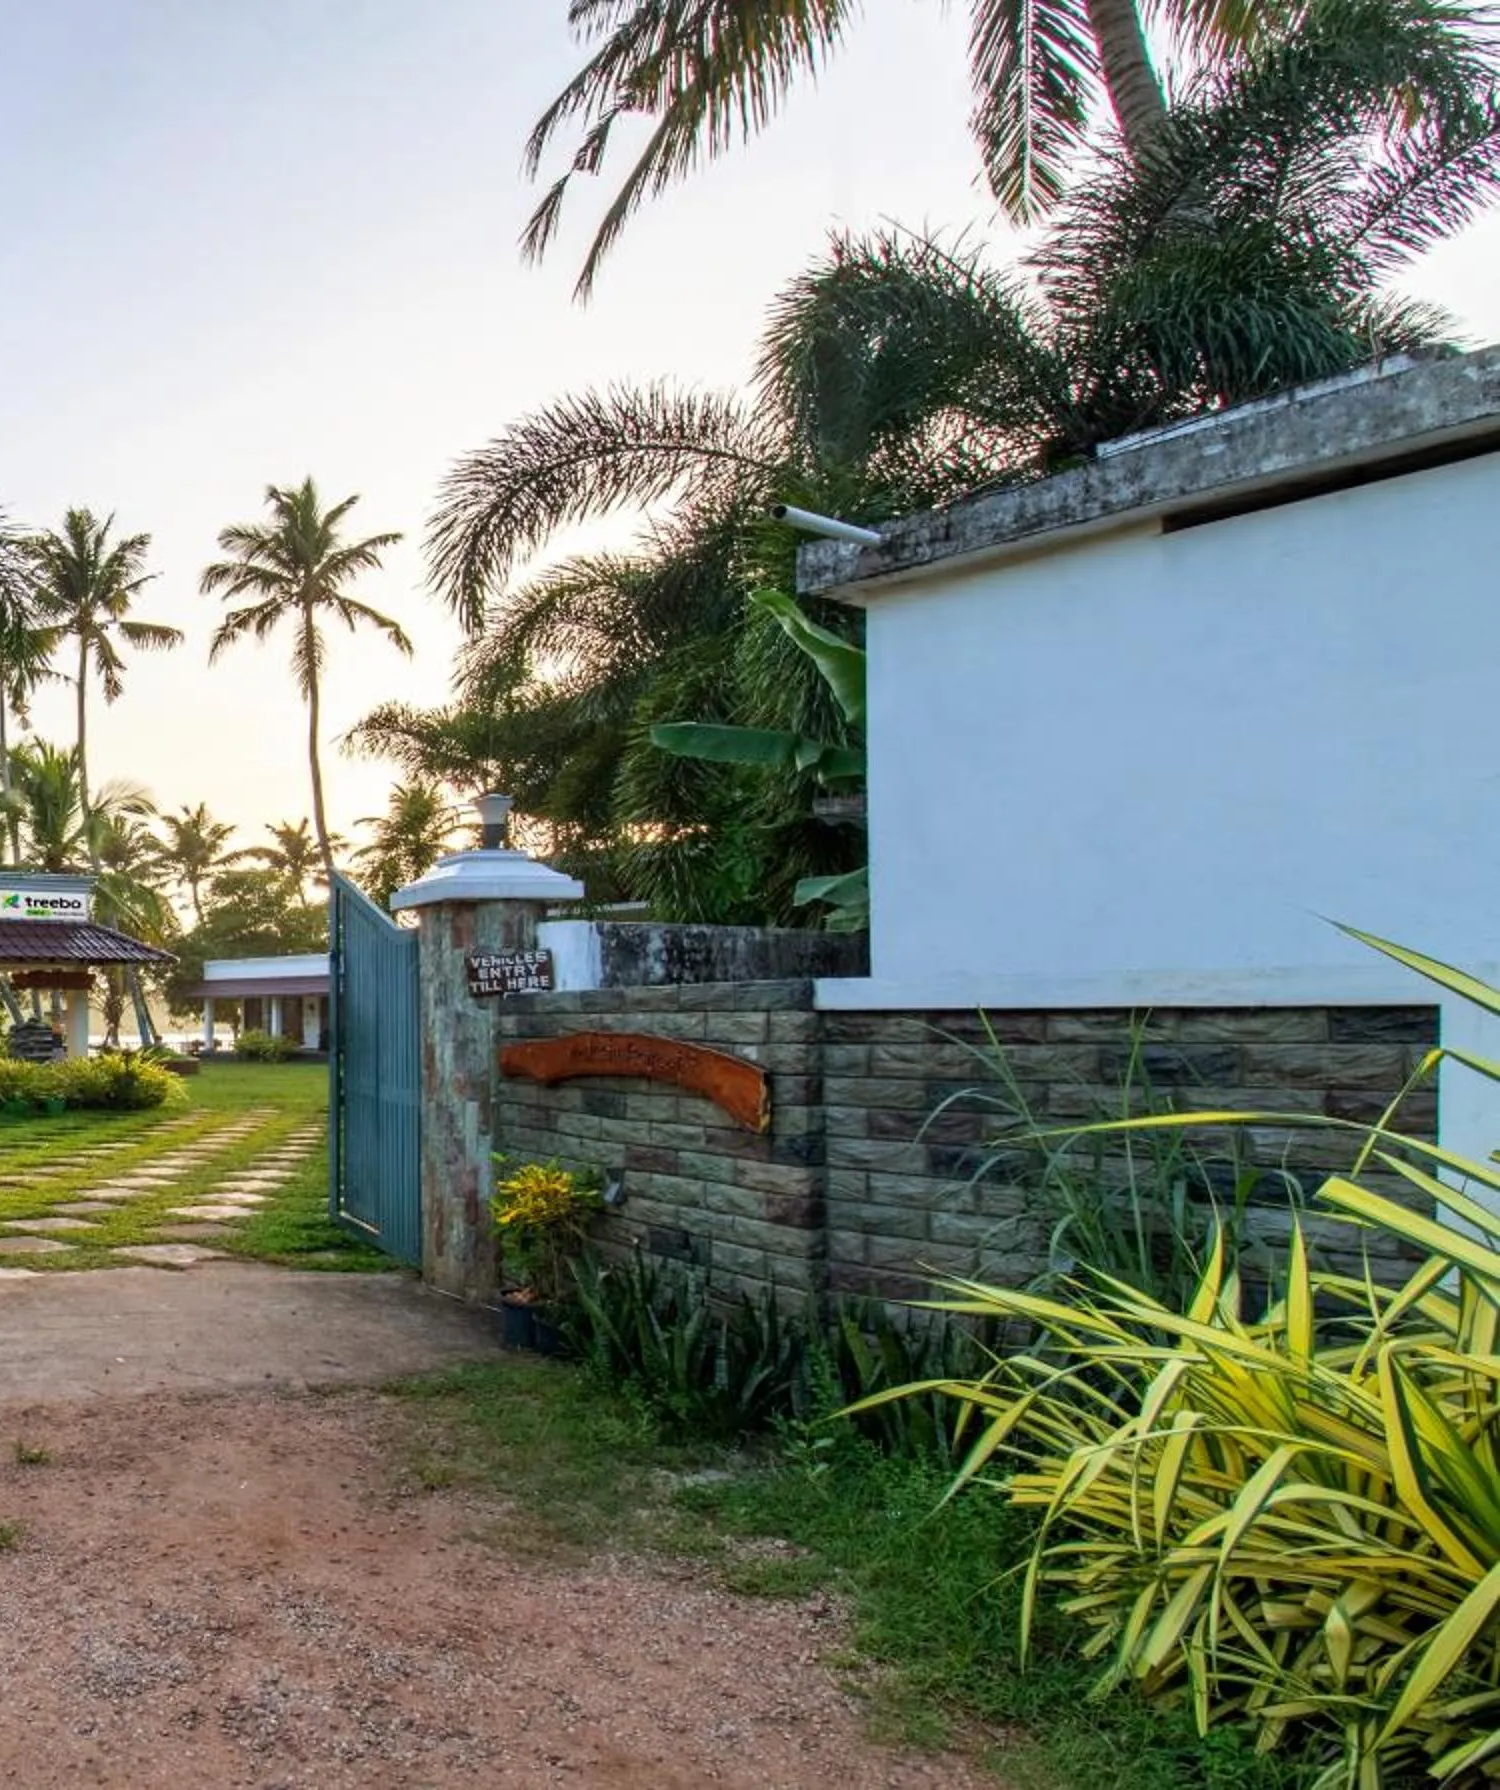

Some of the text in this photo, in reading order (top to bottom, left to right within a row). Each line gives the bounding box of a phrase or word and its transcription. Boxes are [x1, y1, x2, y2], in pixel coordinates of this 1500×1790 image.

[24, 896, 81, 909] treebo
[469, 951, 548, 969] VEHICLES
[478, 963, 539, 980] ENTRY
[469, 975, 549, 993] TILL HERE
